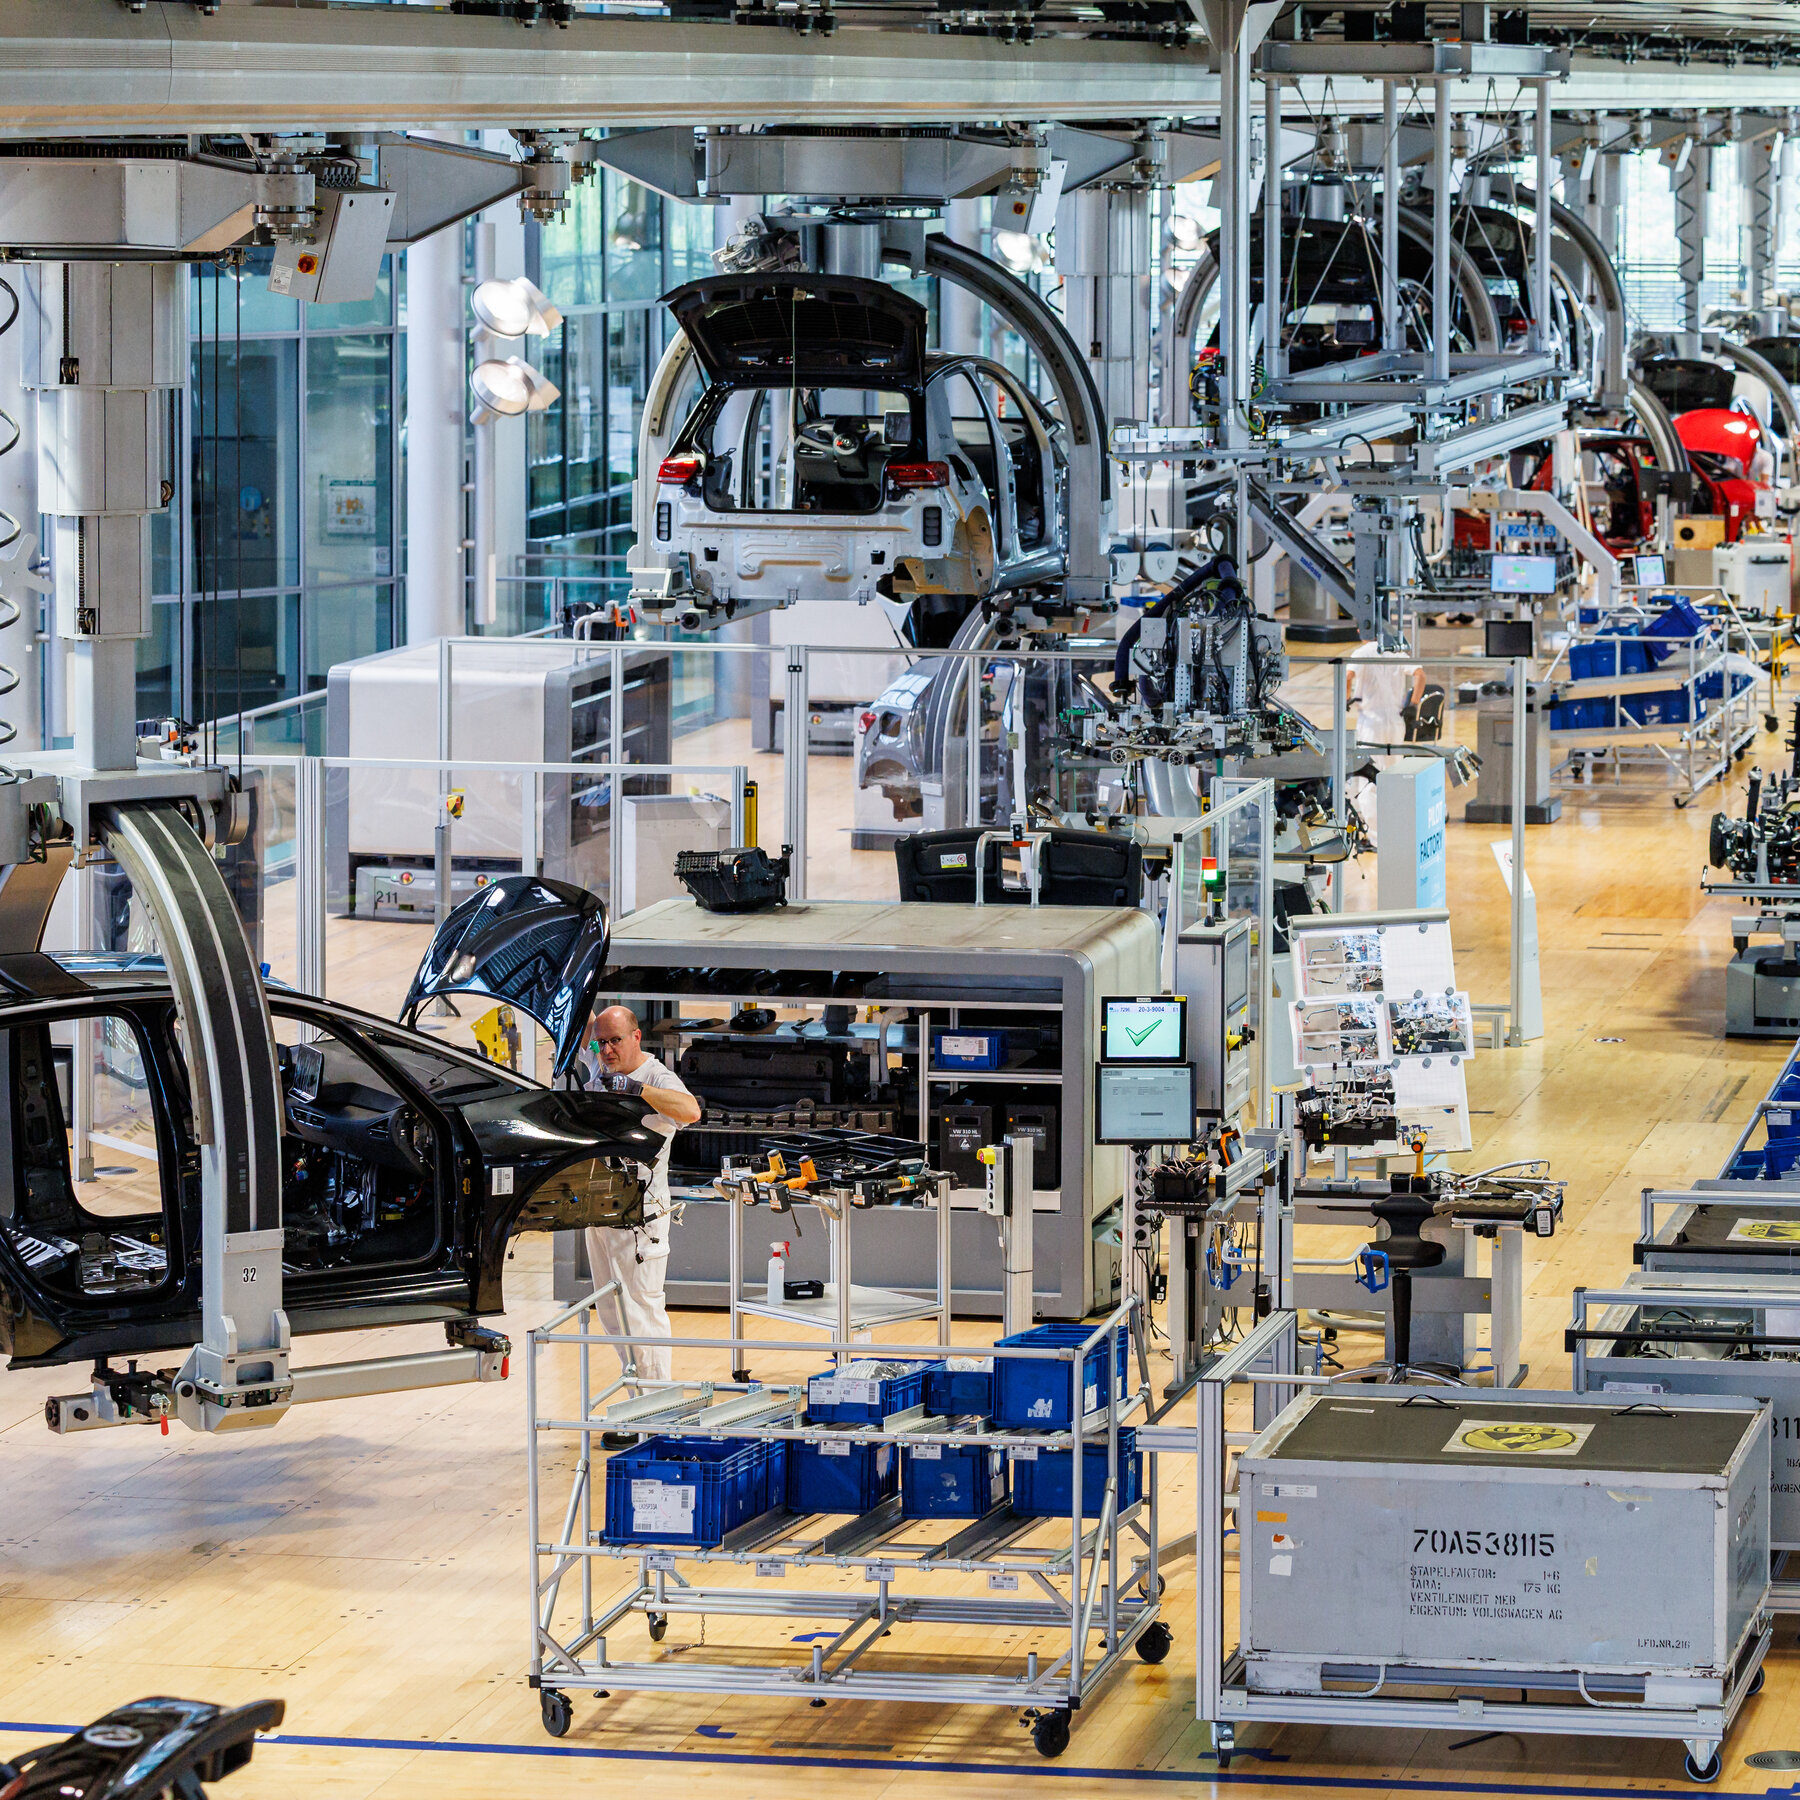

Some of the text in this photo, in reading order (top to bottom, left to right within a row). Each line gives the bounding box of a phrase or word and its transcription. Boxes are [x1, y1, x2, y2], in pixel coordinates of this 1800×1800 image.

[1420, 829, 1443, 863] FACTORY
[376, 890, 398, 904] 211
[1755, 920, 1762, 931] 7
[243, 1267, 256, 1282] 32
[1413, 1529, 1555, 1557] 70A538115
[1410, 1566, 1496, 1580] STAPELFAKTOR:
[1411, 1579, 1561, 1594] TARA: 175 KG
[1410, 1592, 1516, 1605] VENTILEINHEIT MEB
[1410, 1605, 1562, 1620] EIGENTUM: VOLKSWAGEN AG
